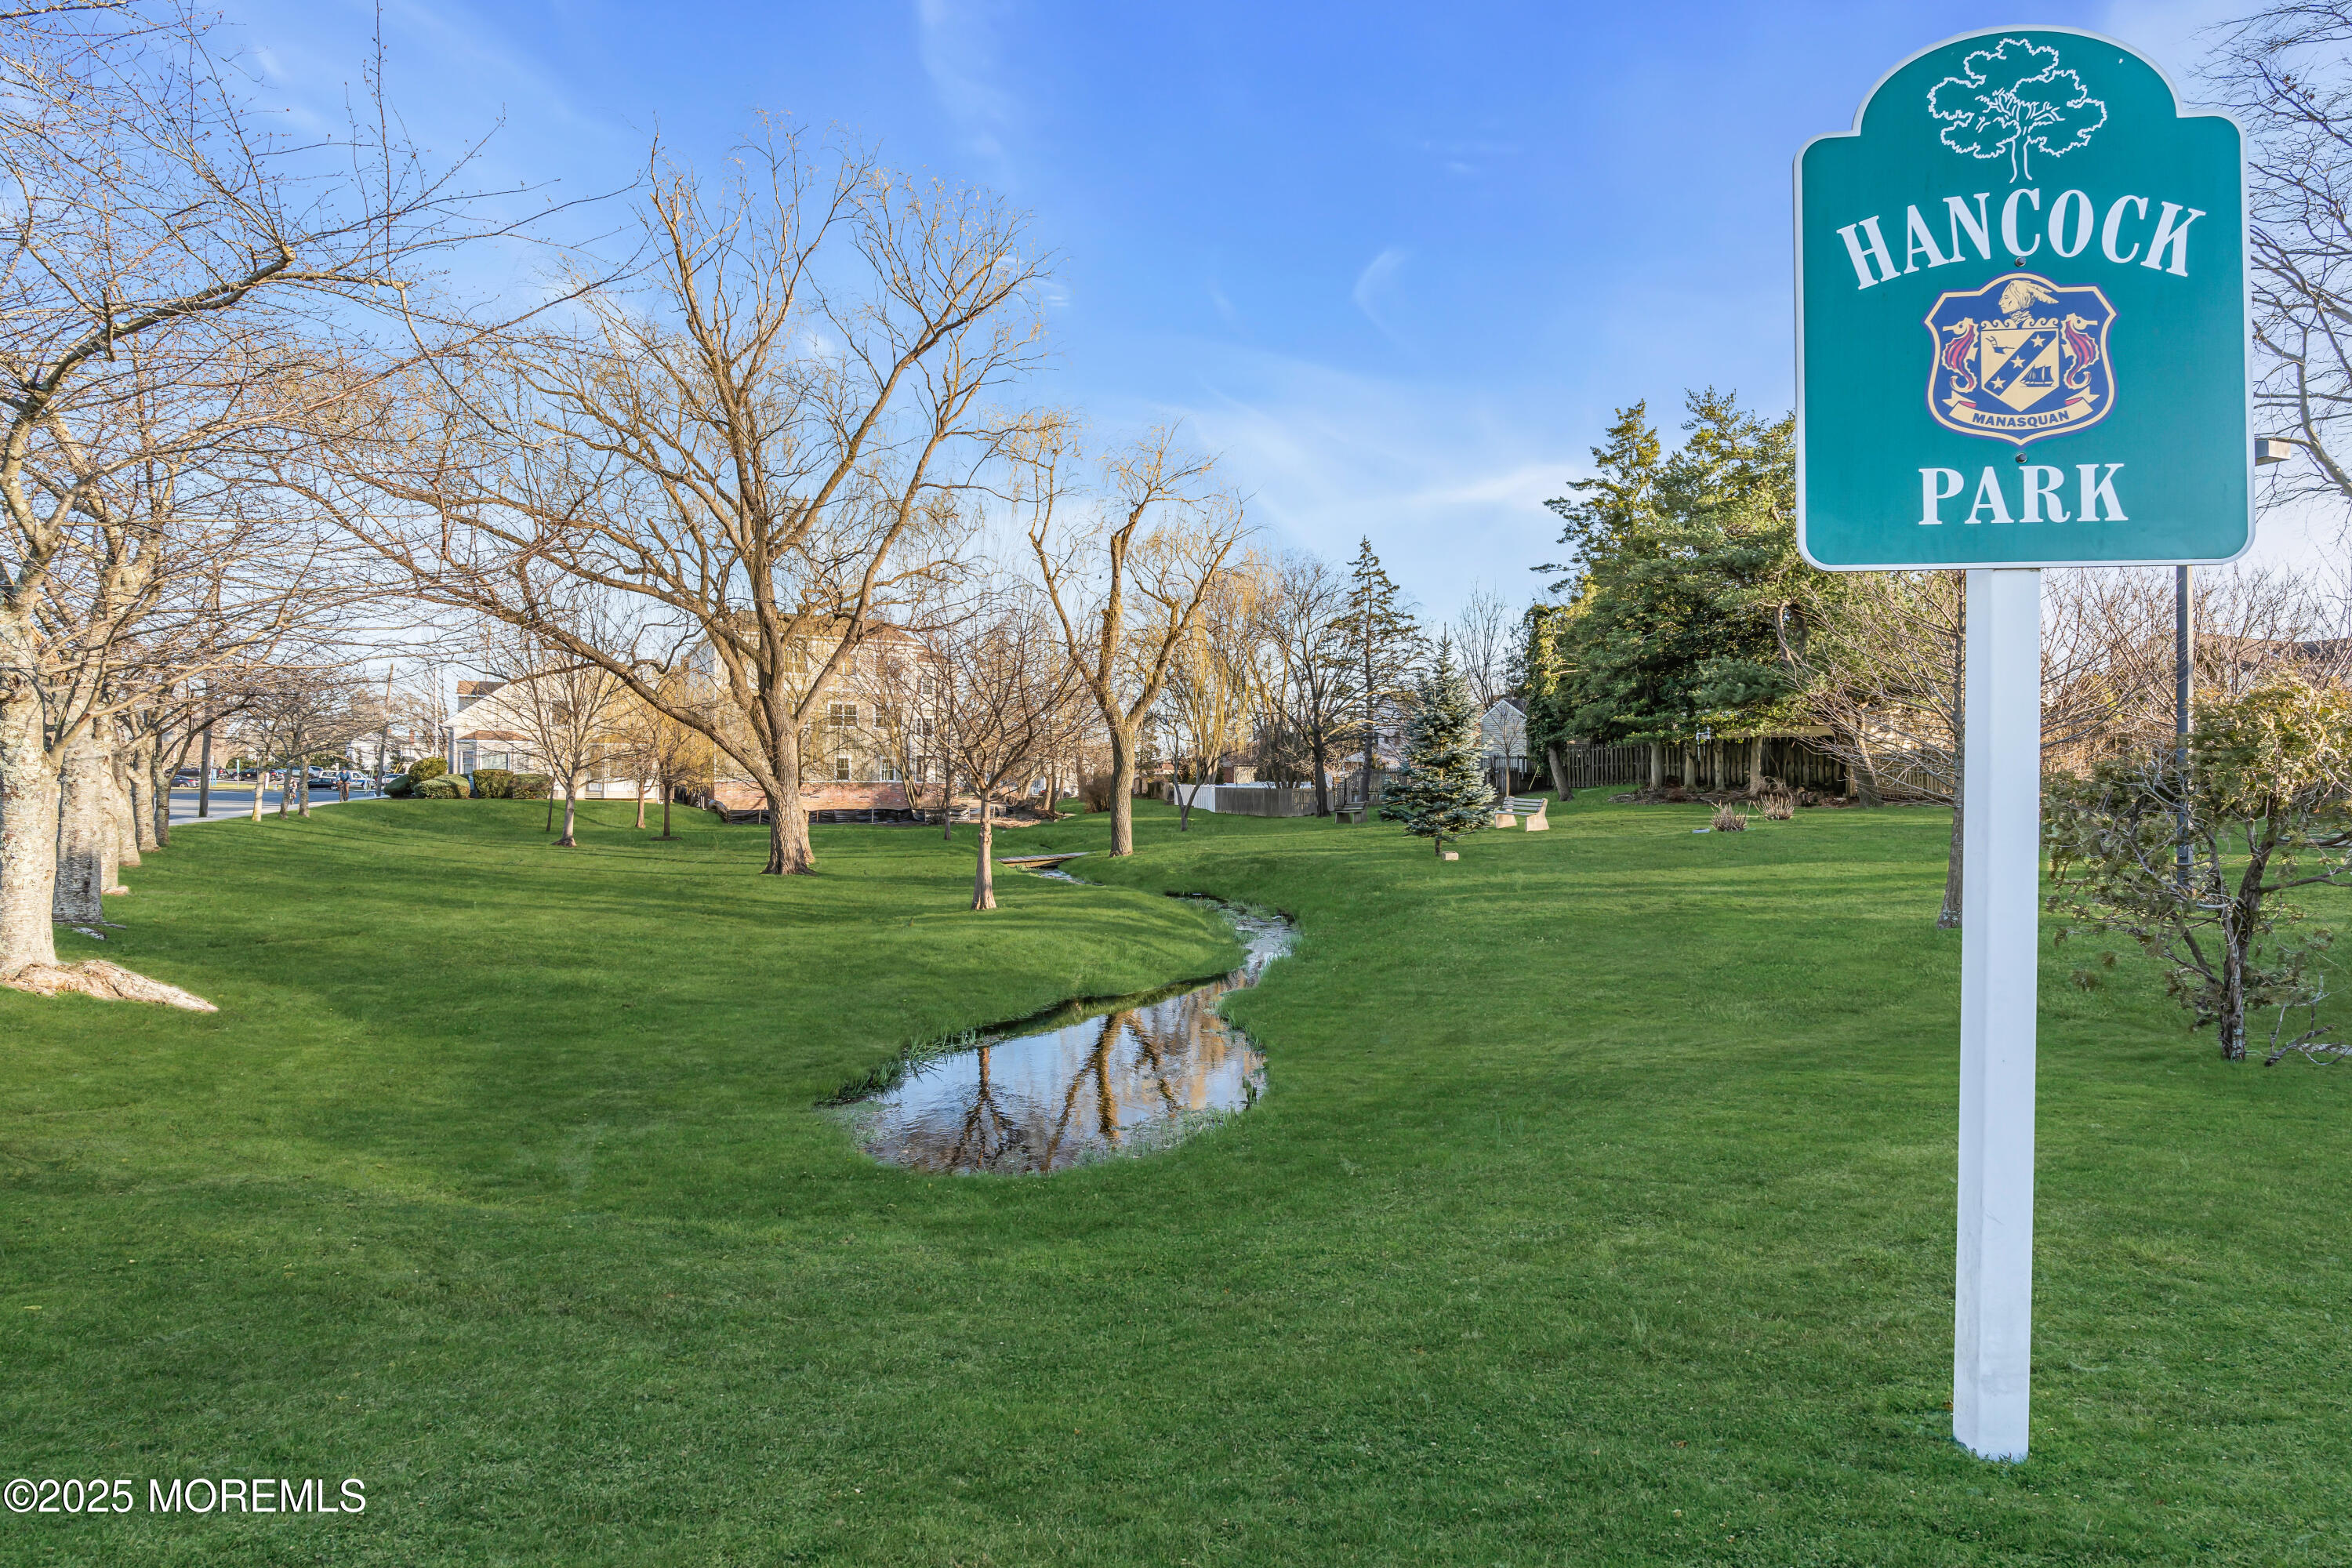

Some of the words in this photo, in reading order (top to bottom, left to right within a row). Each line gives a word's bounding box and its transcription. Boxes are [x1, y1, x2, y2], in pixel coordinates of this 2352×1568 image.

[1836, 188, 2206, 290] HANCOCK
[1973, 410, 2070, 428] MANASQUAN
[1918, 463, 2129, 525] PARK
